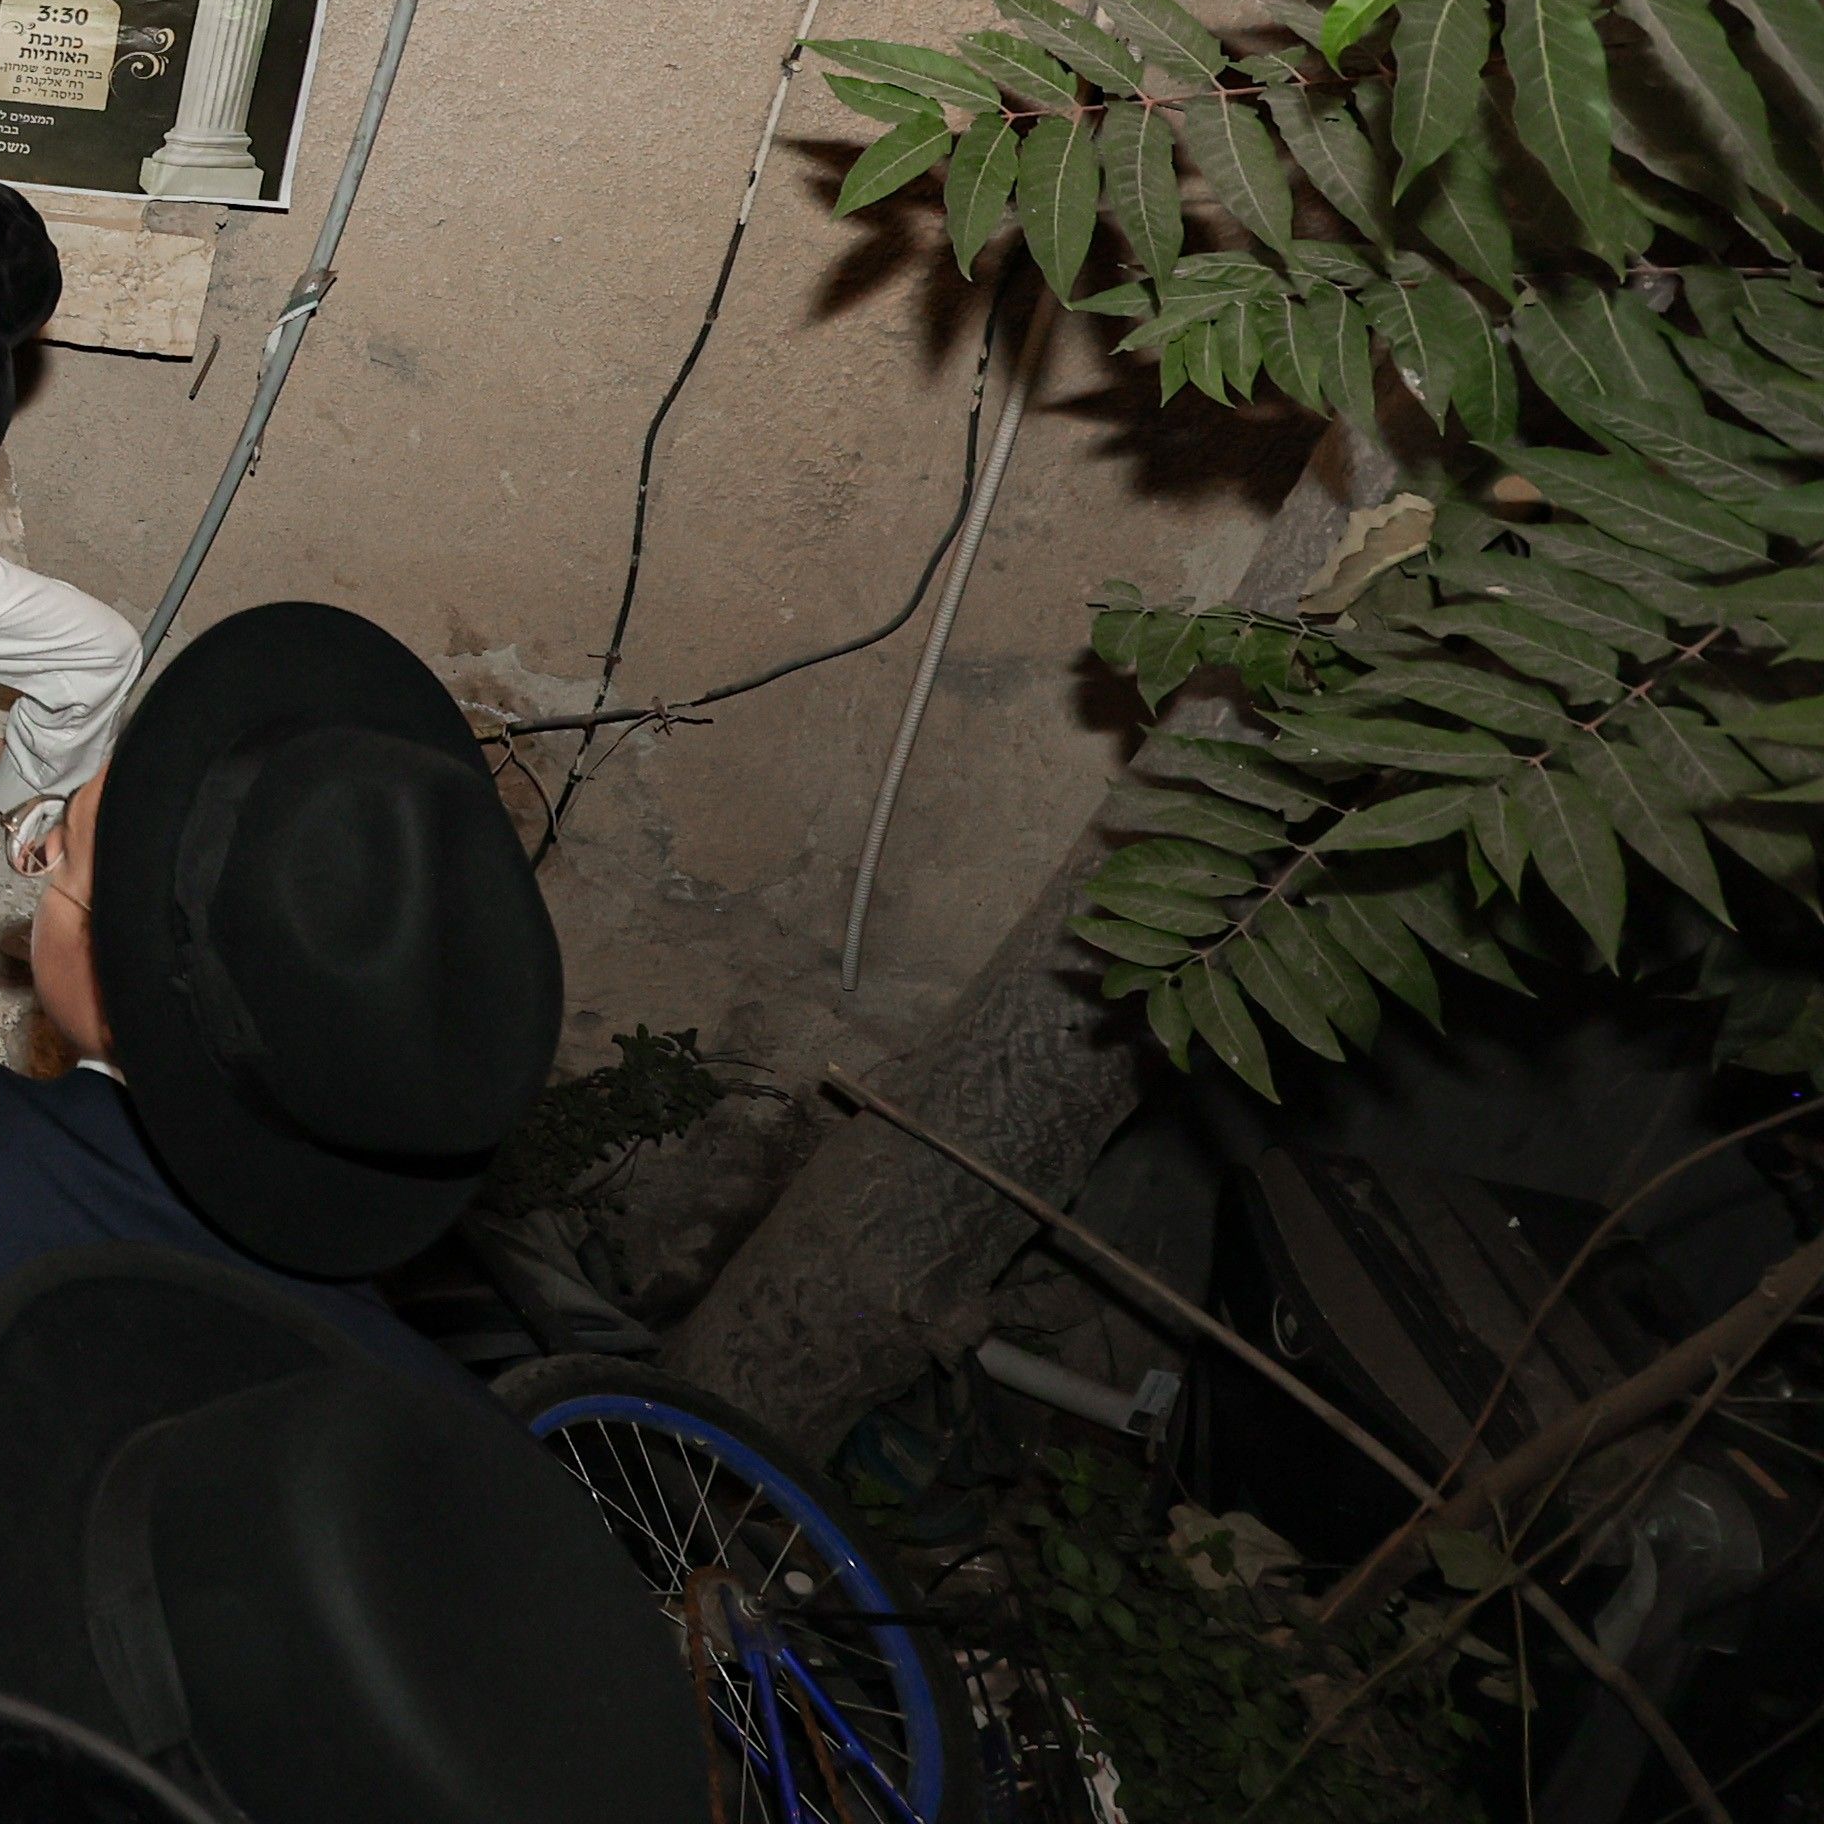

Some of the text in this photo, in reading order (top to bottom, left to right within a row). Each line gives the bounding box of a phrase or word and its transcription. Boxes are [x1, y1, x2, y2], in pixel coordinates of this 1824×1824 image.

[37, 5, 89, 25] 3:30
[28, 33, 84, 48] כתיבת
[19, 47, 89, 64] האותיות
[4, 62, 39, 73] שמחון
[74, 68, 102, 80] בבית
[15, 75, 22, 83] 8
[26, 76, 63, 87] אלקנה
[12, 86, 84, 101] כניסה י-ם
[10, 113, 55, 126] המצפים
